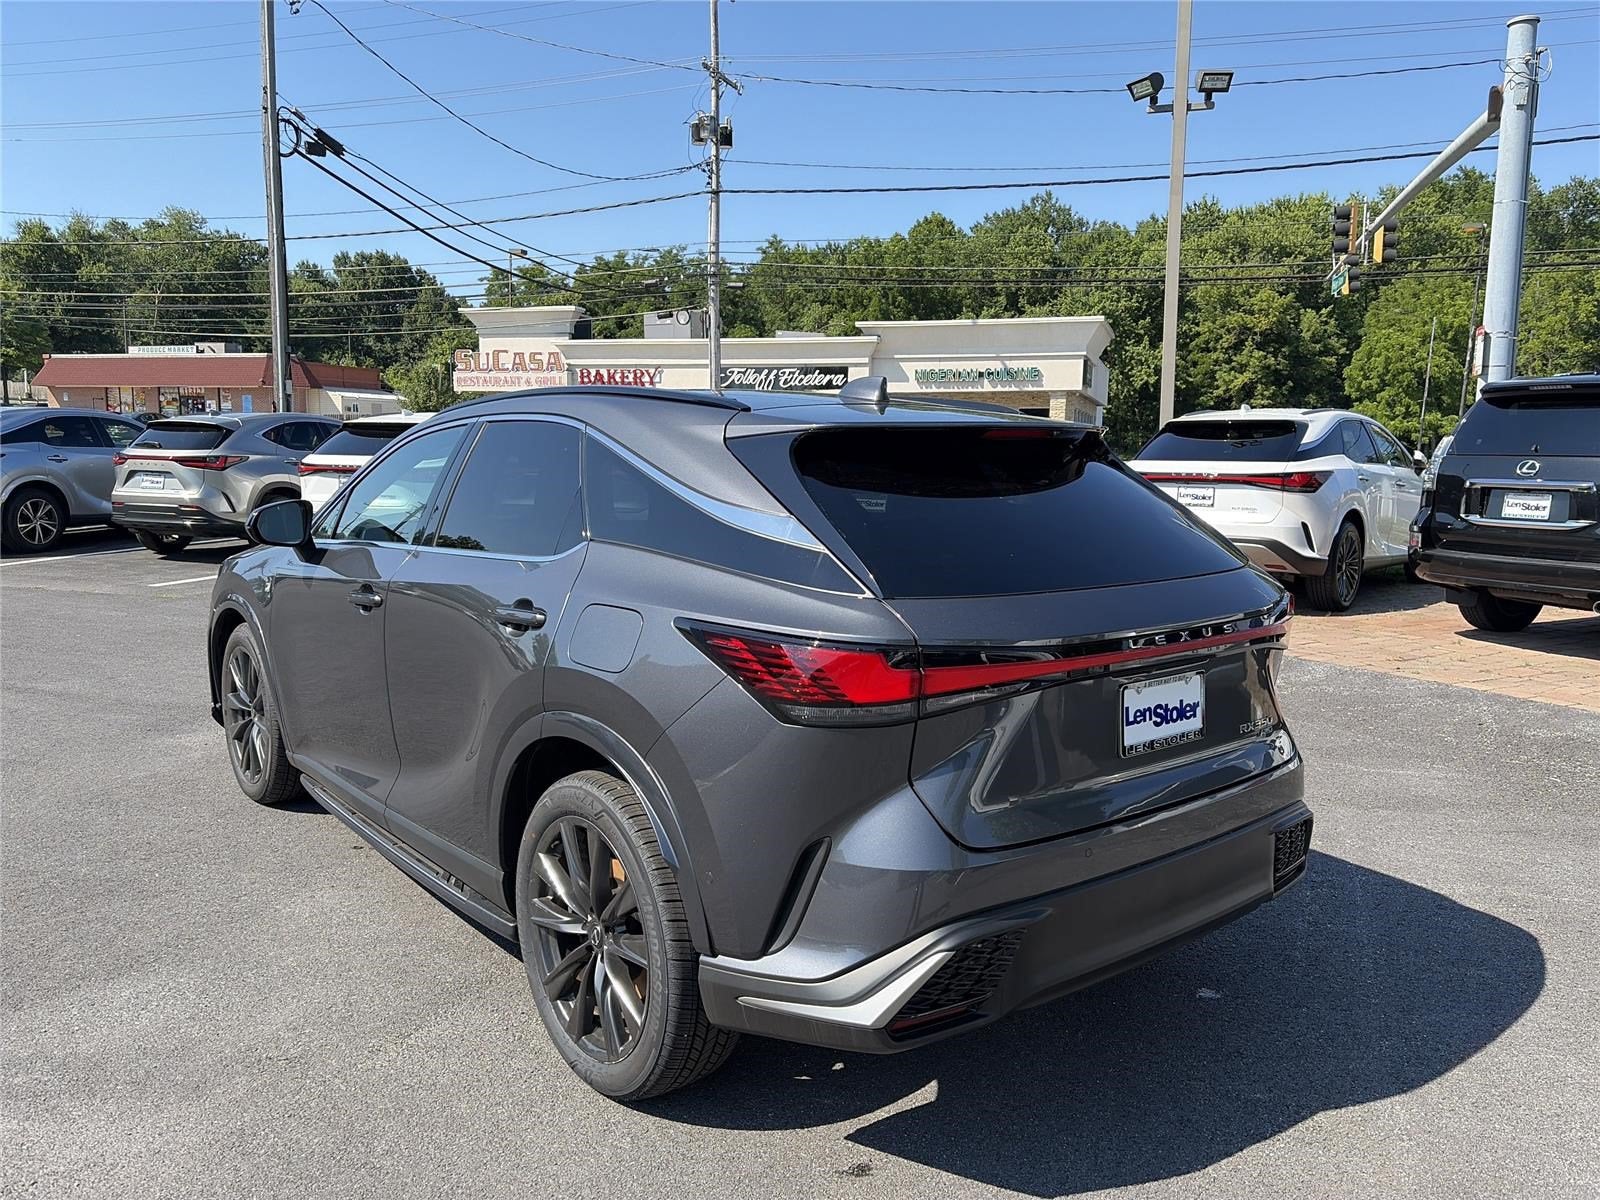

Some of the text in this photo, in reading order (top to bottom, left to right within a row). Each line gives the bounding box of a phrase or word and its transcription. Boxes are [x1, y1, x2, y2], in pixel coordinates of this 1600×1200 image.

[456, 375, 564, 387] RESTAURANT & GRILL
[579, 366, 661, 387] BAKERY
[778, 367, 847, 388] Etcetera
[915, 366, 1040, 381] NIGERIAN CUISINE
[1128, 623, 1235, 649] LEXUS
[1126, 730, 1202, 755] LEN STOLER
